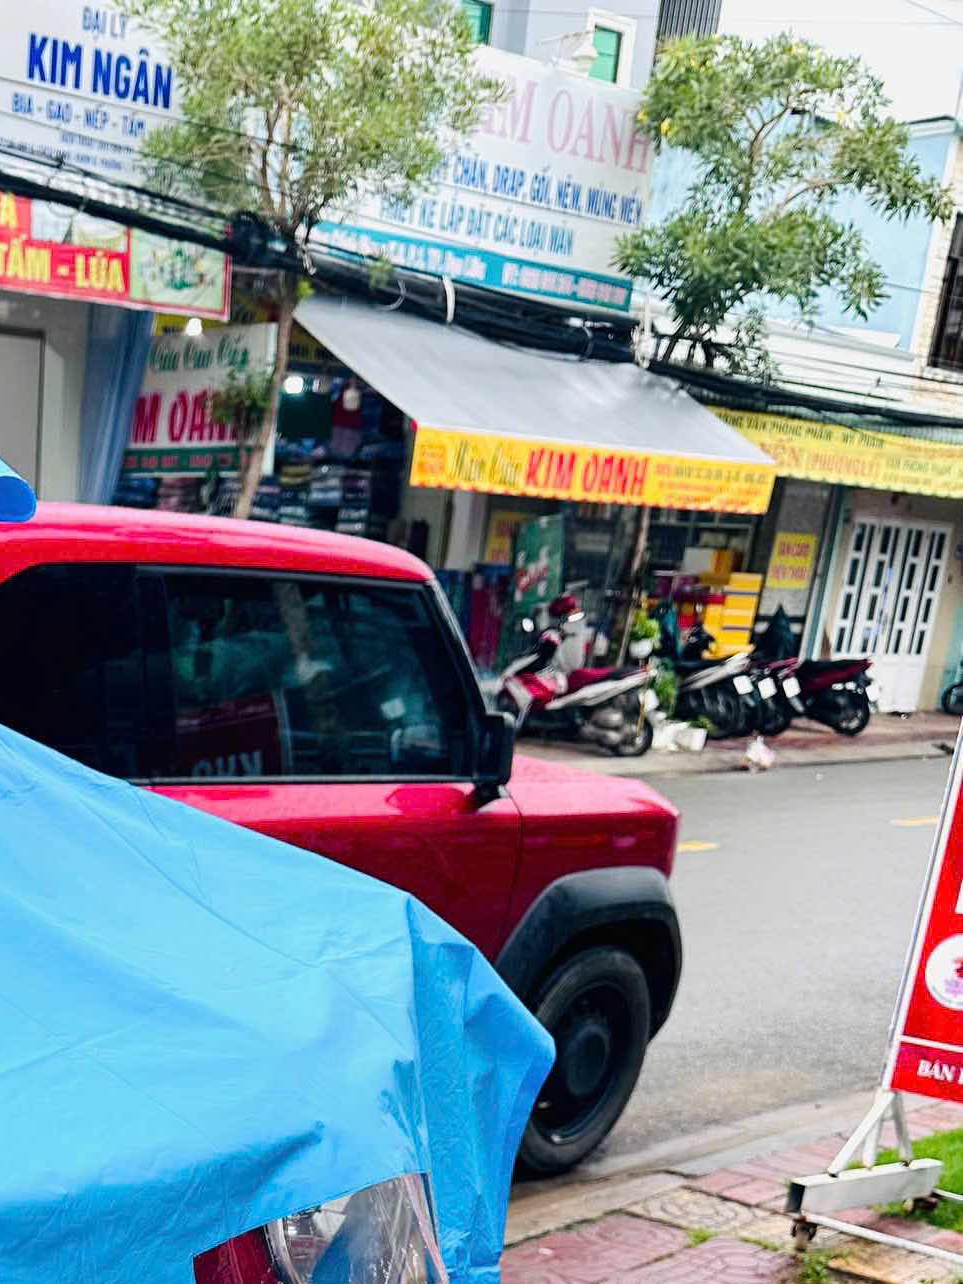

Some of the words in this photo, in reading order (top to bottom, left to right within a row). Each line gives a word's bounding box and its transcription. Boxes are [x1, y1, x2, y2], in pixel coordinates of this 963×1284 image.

[28, 32, 83, 90] KIM
[92, 48, 173, 109] NGÂN
[546, 88, 652, 175] OANH
[525, 446, 579, 492] KIM
[582, 451, 651, 498] OANH
[917, 1058, 956, 1082] BÁN
